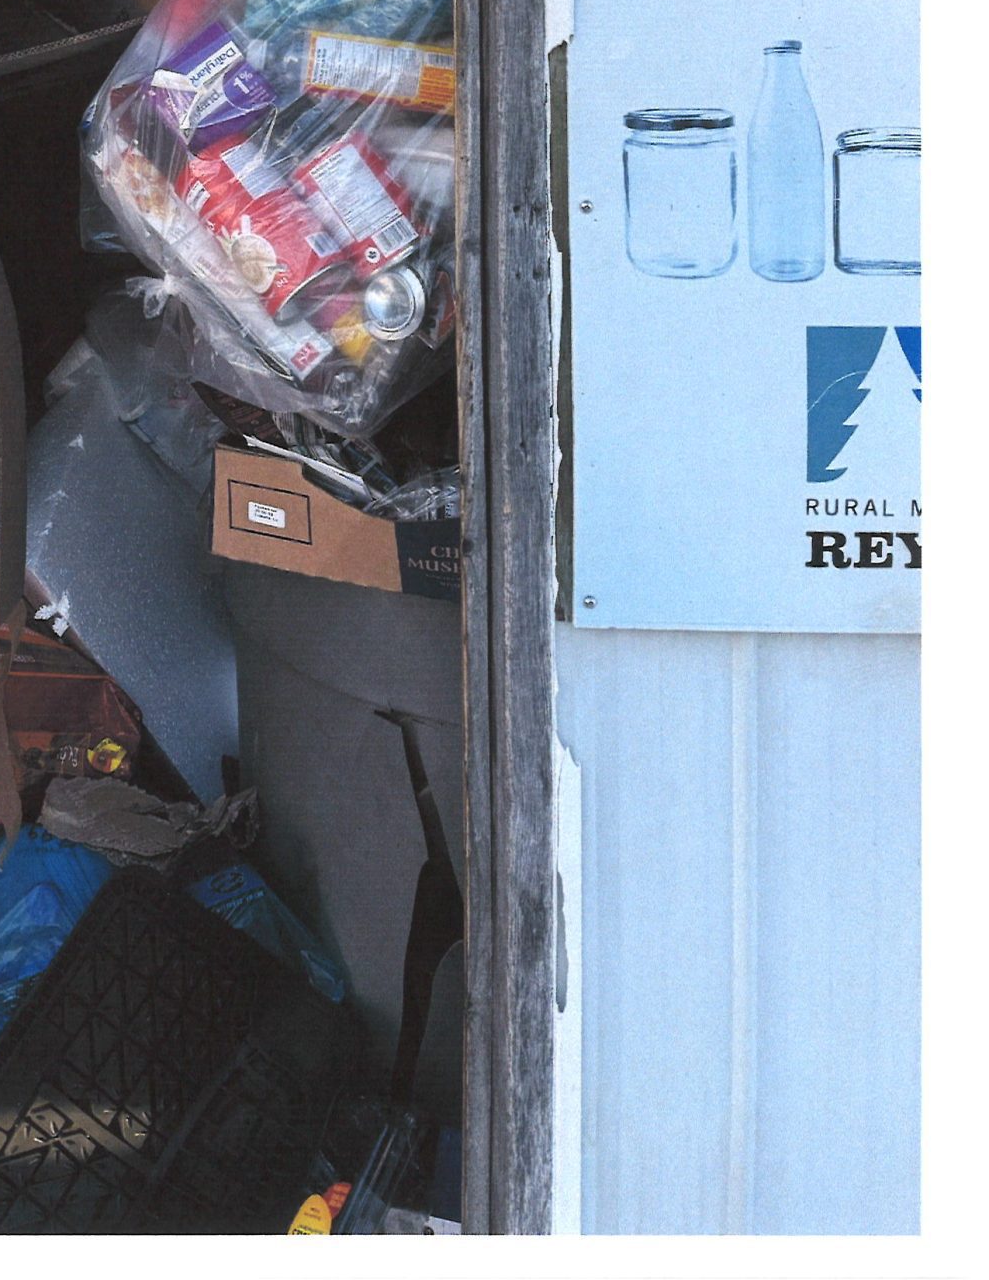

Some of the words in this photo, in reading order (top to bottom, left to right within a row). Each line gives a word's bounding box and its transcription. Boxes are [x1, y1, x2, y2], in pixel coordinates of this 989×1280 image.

[233, 71, 253, 95] 1%
[806, 498, 895, 516] RURAL
[805, 531, 922, 569] REY
